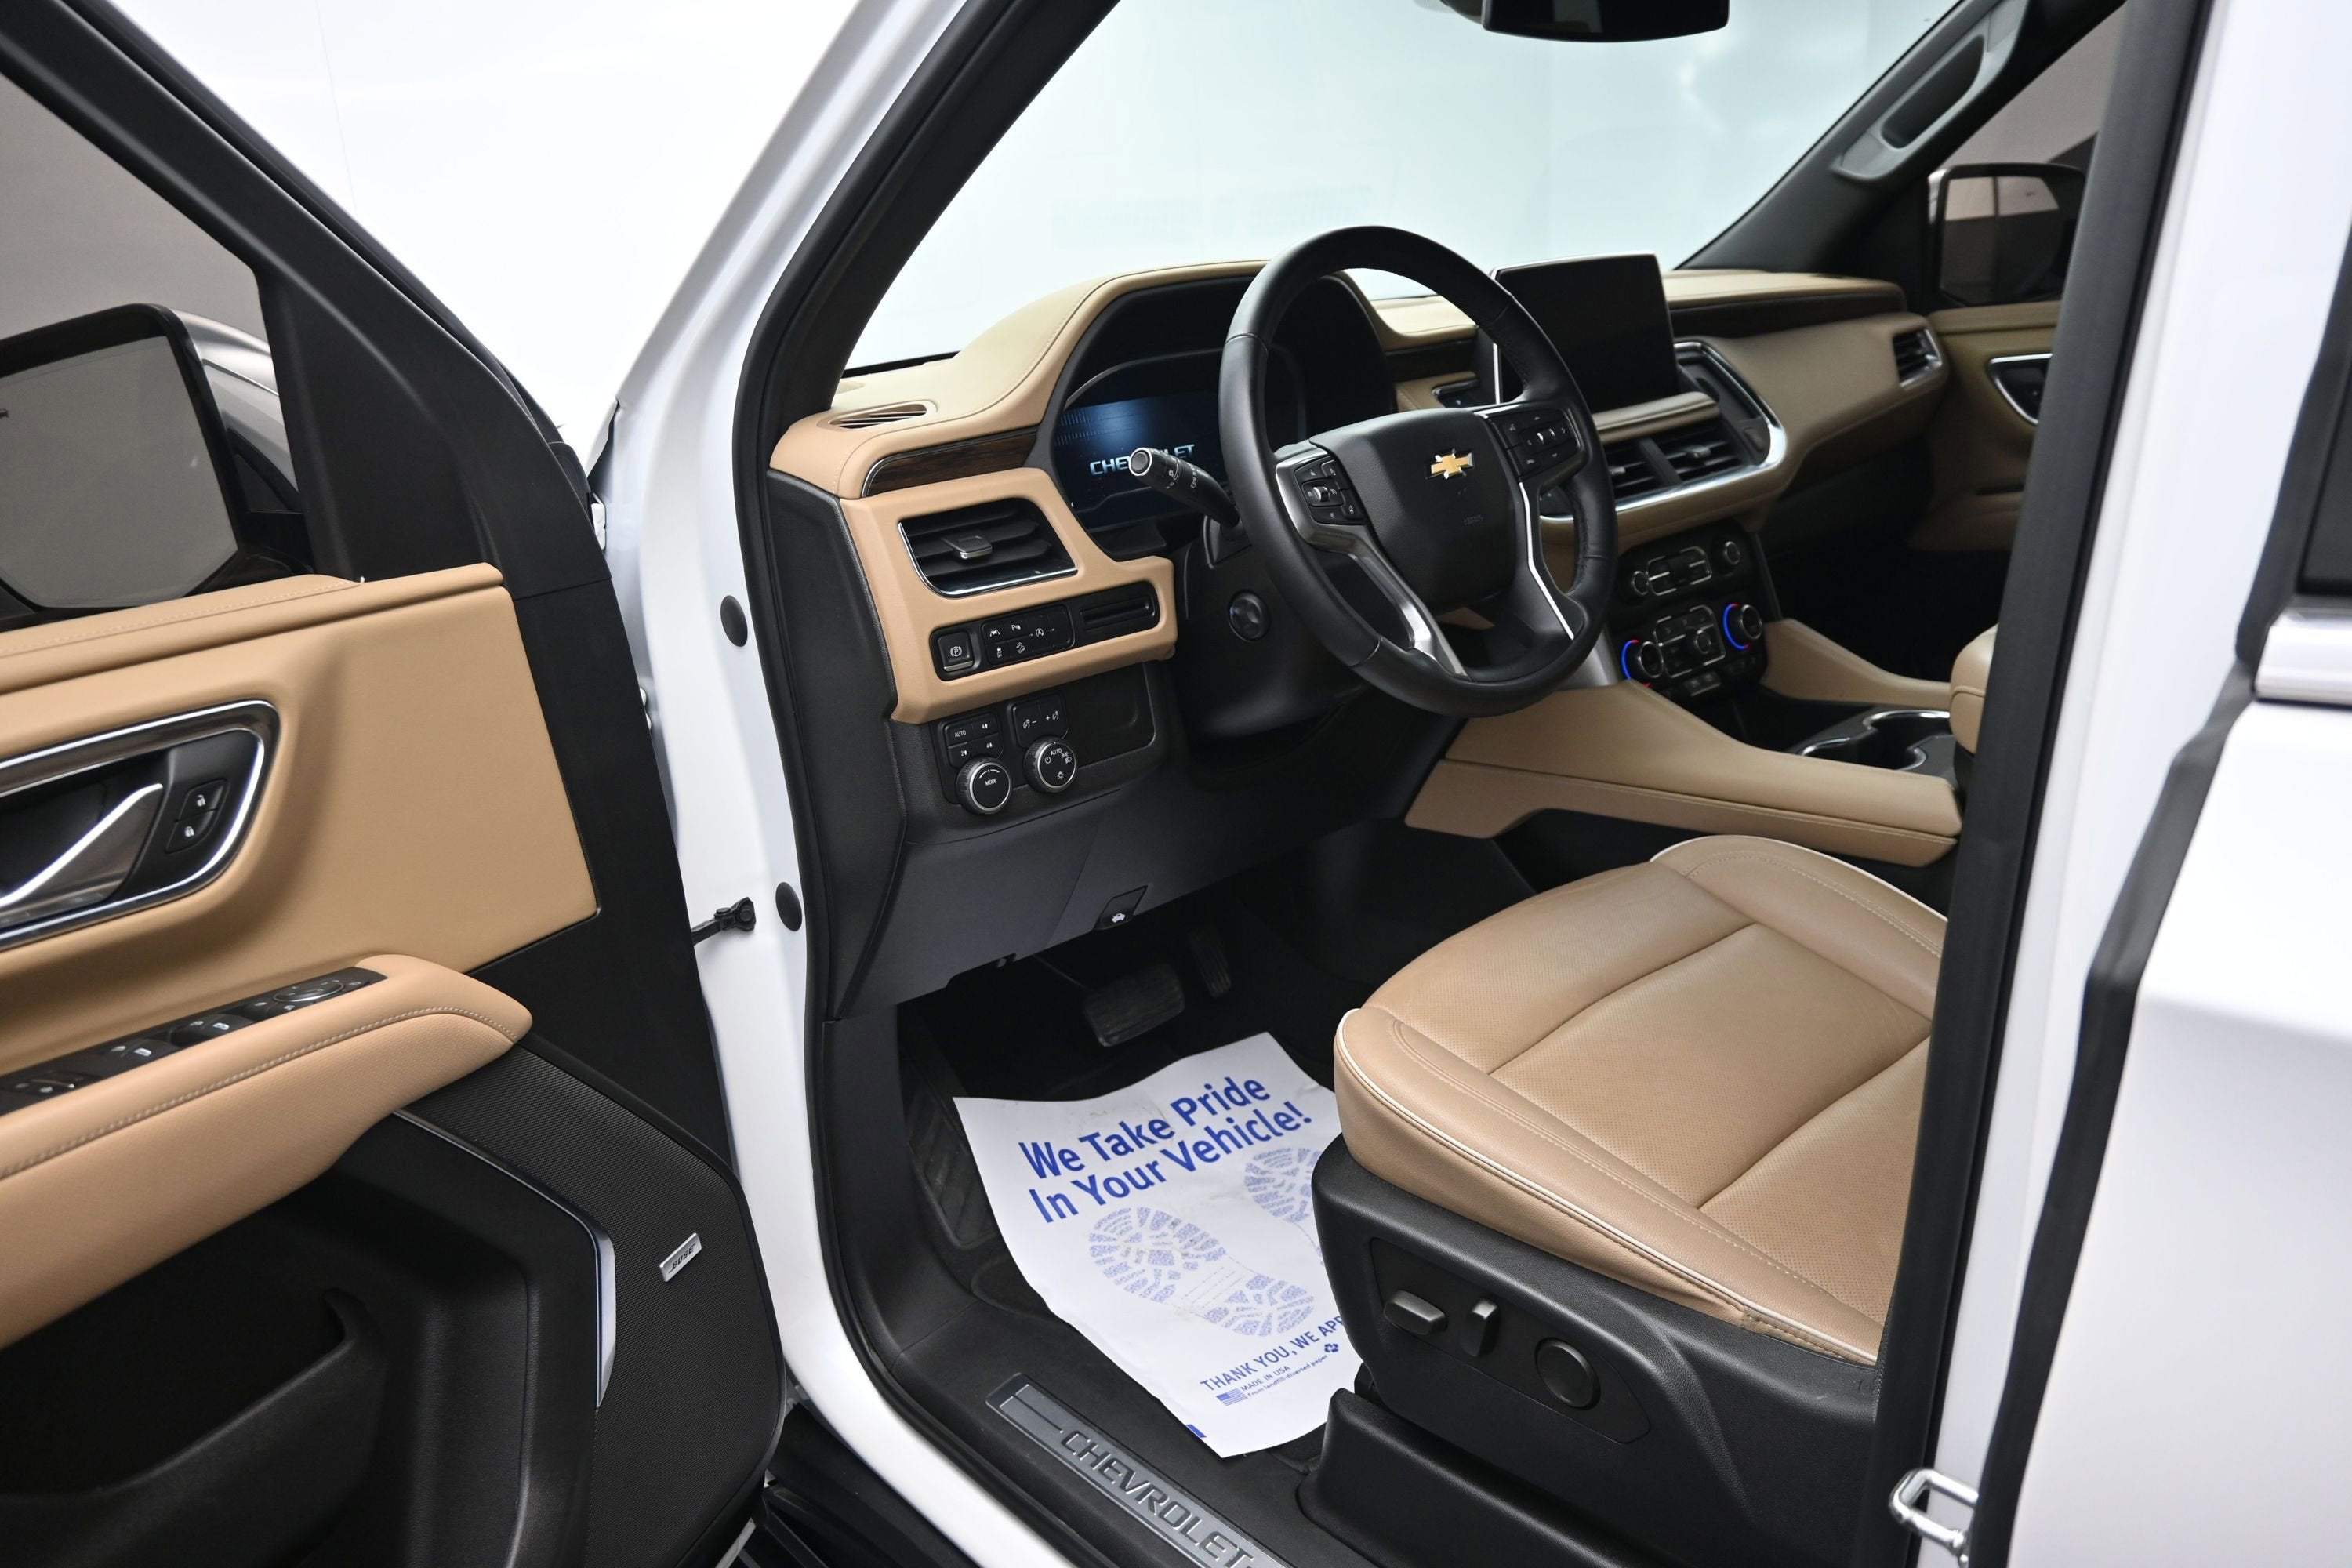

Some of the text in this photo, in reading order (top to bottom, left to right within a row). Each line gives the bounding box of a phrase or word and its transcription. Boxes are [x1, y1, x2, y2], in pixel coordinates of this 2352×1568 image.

[1051, 747, 1062, 756] AUTO
[1018, 1076, 1271, 1179] We Take Pride
[1029, 1101, 1312, 1223] In Your Vehicle!
[669, 1243, 696, 1274] BOSE
[1200, 1363, 1258, 1391] THANK
[1253, 1346, 1298, 1367] YOU,
[1290, 1331, 1320, 1349] WE
[1241, 1379, 1263, 1392] MADE
[1273, 1366, 1291, 1376] USA
[1311, 1355, 1328, 1367] paper
[1061, 1429, 1254, 1568] CHEVROLET
